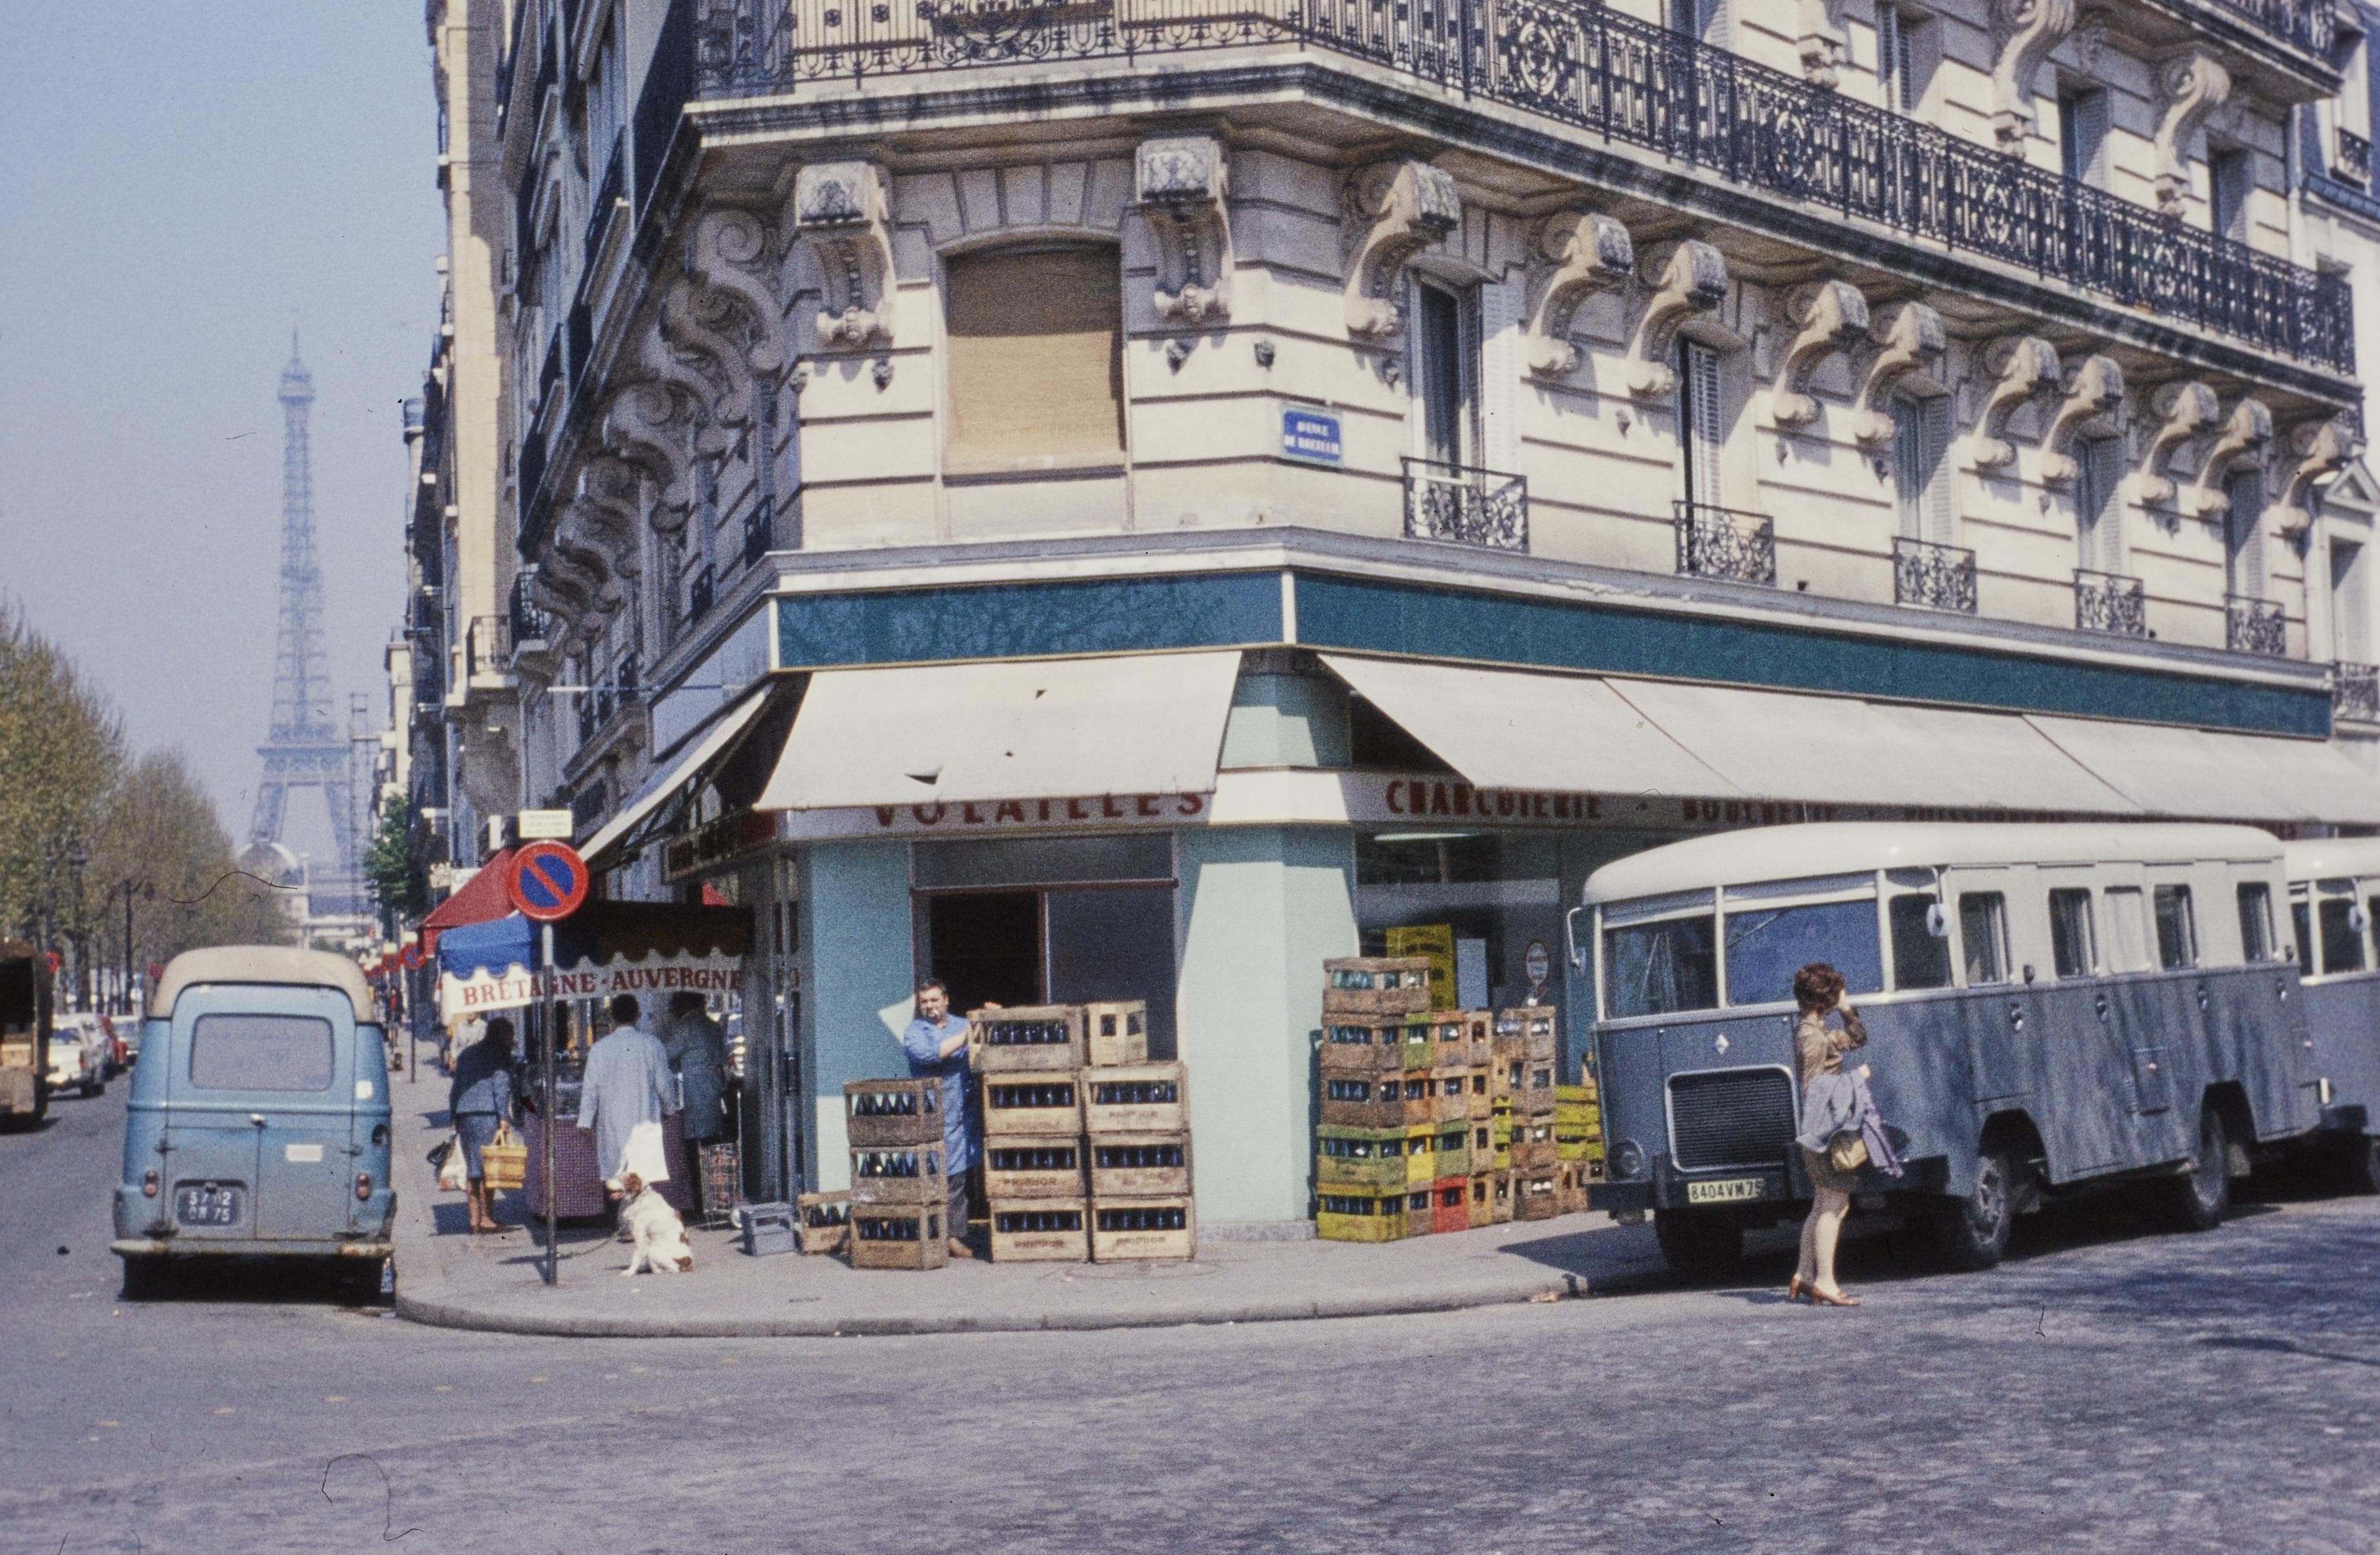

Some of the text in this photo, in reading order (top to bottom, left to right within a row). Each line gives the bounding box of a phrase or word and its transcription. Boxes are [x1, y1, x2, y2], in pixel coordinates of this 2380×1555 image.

[874, 793, 1204, 827] VOLAILLES
[1386, 780, 1602, 820] CHARCUTERIE
[610, 967, 741, 992] AUVERGNE
